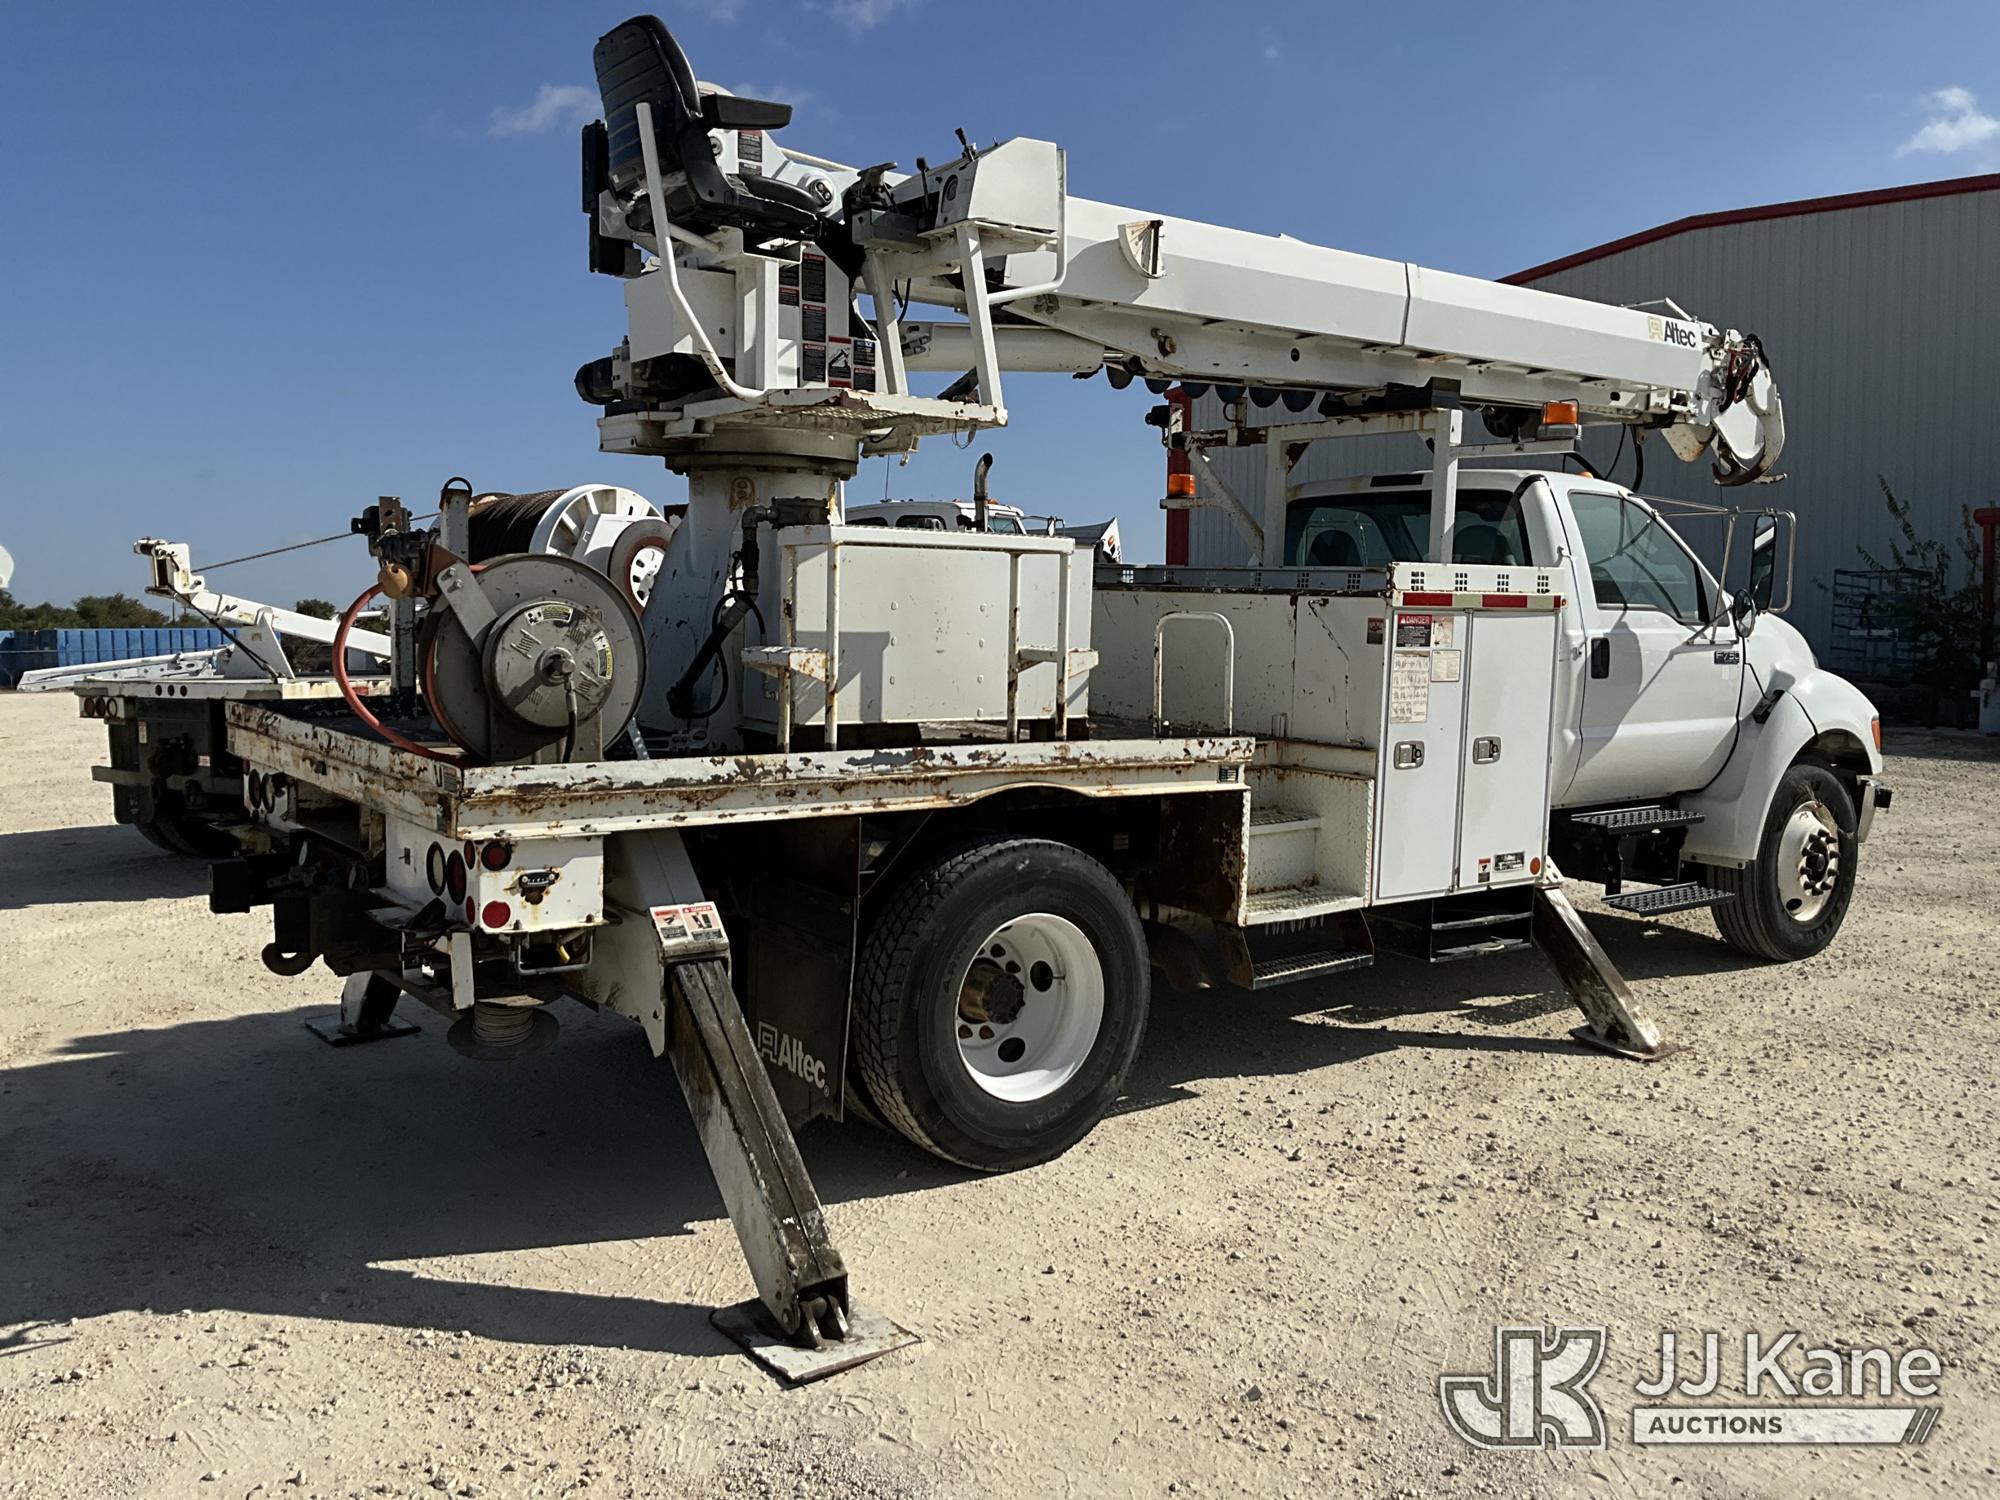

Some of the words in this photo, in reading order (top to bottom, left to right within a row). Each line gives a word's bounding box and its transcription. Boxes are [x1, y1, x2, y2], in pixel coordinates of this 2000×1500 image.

[1664, 320, 1696, 348] Altec
[1406, 616, 1430, 625] DANGER
[777, 1032, 826, 1089] Altec
